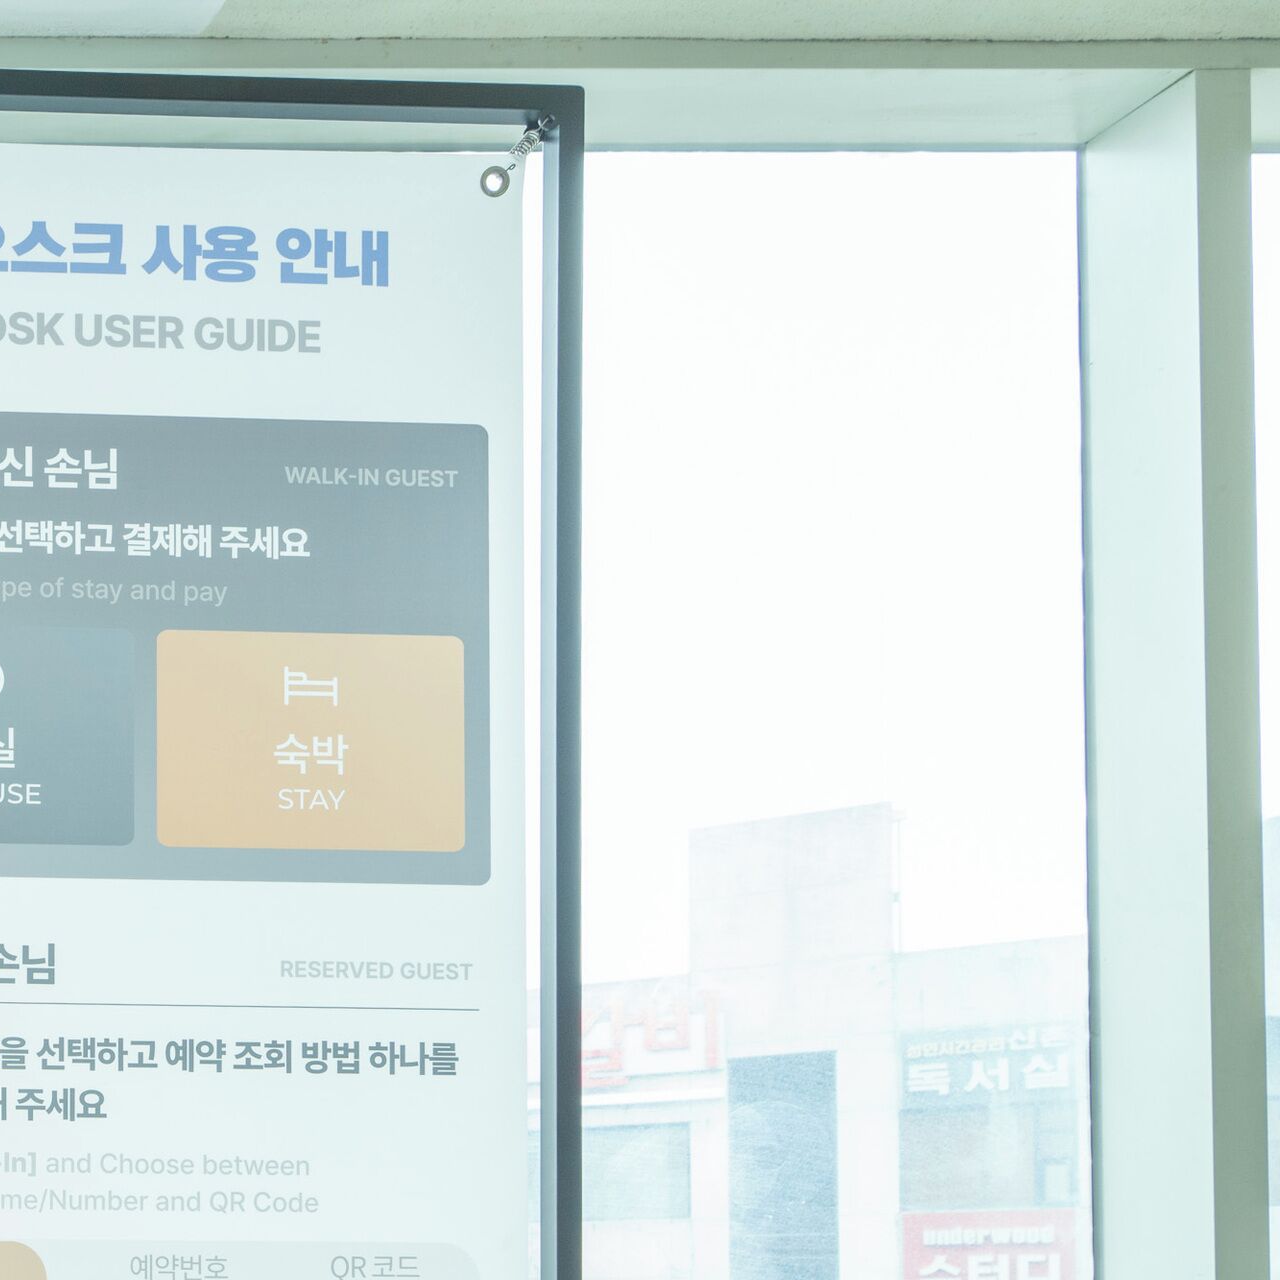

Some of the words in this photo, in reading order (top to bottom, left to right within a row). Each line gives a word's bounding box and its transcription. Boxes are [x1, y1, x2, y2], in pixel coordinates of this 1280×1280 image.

[142, 225, 258, 282] 사용
[276, 228, 388, 287] 안내
[75, 314, 184, 349] USER
[194, 317, 320, 353] GUIDE
[44, 448, 117, 489] 손님
[285, 467, 379, 485] WALK-IN
[386, 469, 458, 487] GUEST
[123, 523, 211, 558] 결제해
[220, 526, 310, 559] 주세요
[40, 577, 64, 598] of
[72, 580, 123, 604] stay
[131, 580, 175, 600] and
[184, 586, 227, 607] pay
[274, 734, 349, 775] 숙박
[279, 789, 345, 810] STAY
[281, 960, 393, 979] RESERVED
[400, 962, 473, 980] GUEST
[37, 1037, 158, 1071] 선택하고
[166, 1039, 226, 1072] 예약
[233, 1040, 291, 1073] 조회
[302, 1041, 359, 1074] 방법
[369, 1042, 459, 1075] 하나를
[907, 1053, 1070, 1095] 독서실
[46, 1153, 91, 1173] and
[100, 1153, 194, 1174] Choose
[203, 1155, 309, 1176] between
[156, 1191, 200, 1211] and
[210, 1191, 245, 1213] QR
[254, 1192, 318, 1213] Code
[131, 1255, 228, 1280] 예약번호
[372, 1256, 420, 1277] 코드
